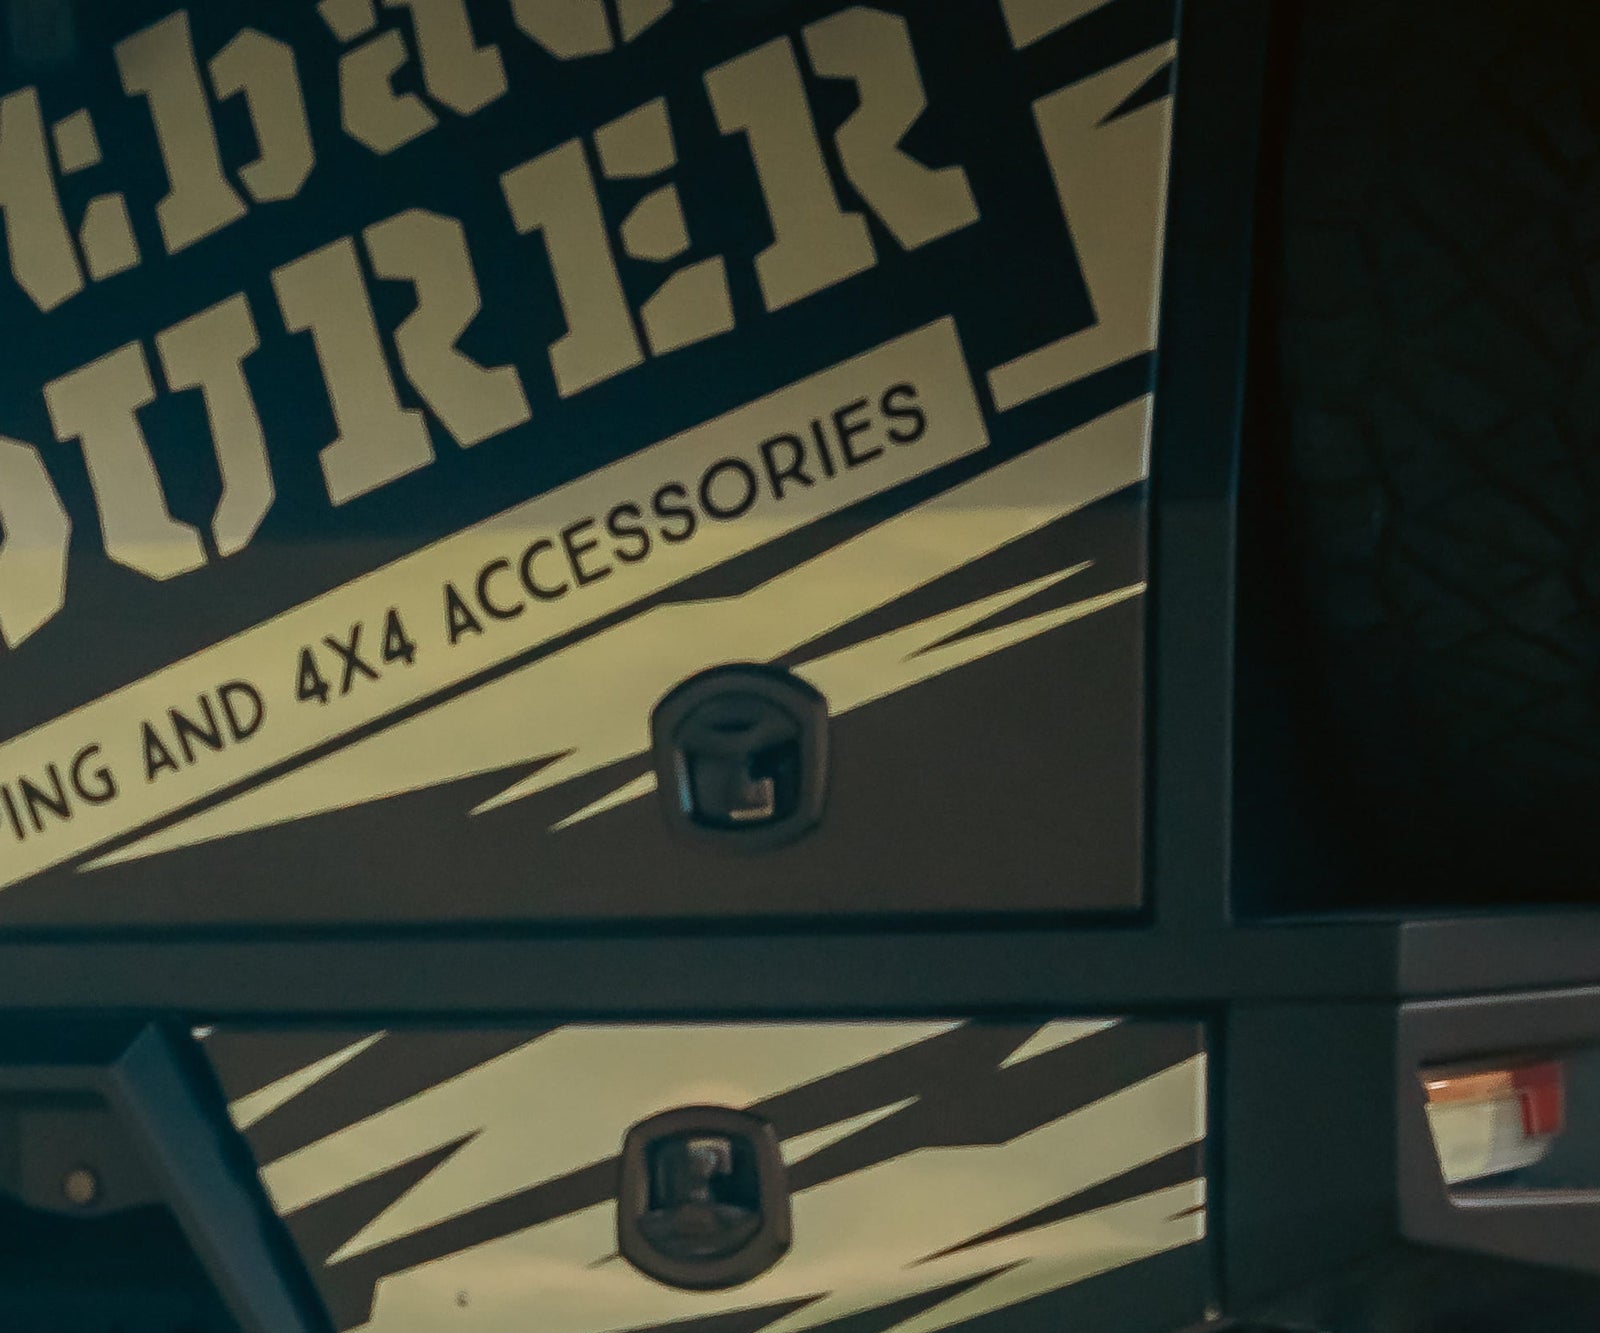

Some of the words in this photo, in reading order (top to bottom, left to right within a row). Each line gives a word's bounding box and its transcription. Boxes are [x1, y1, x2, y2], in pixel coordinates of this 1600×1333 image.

[140, 679, 267, 783] AND
[294, 606, 418, 705] 4X4
[441, 382, 931, 640] ACCESSORIES
